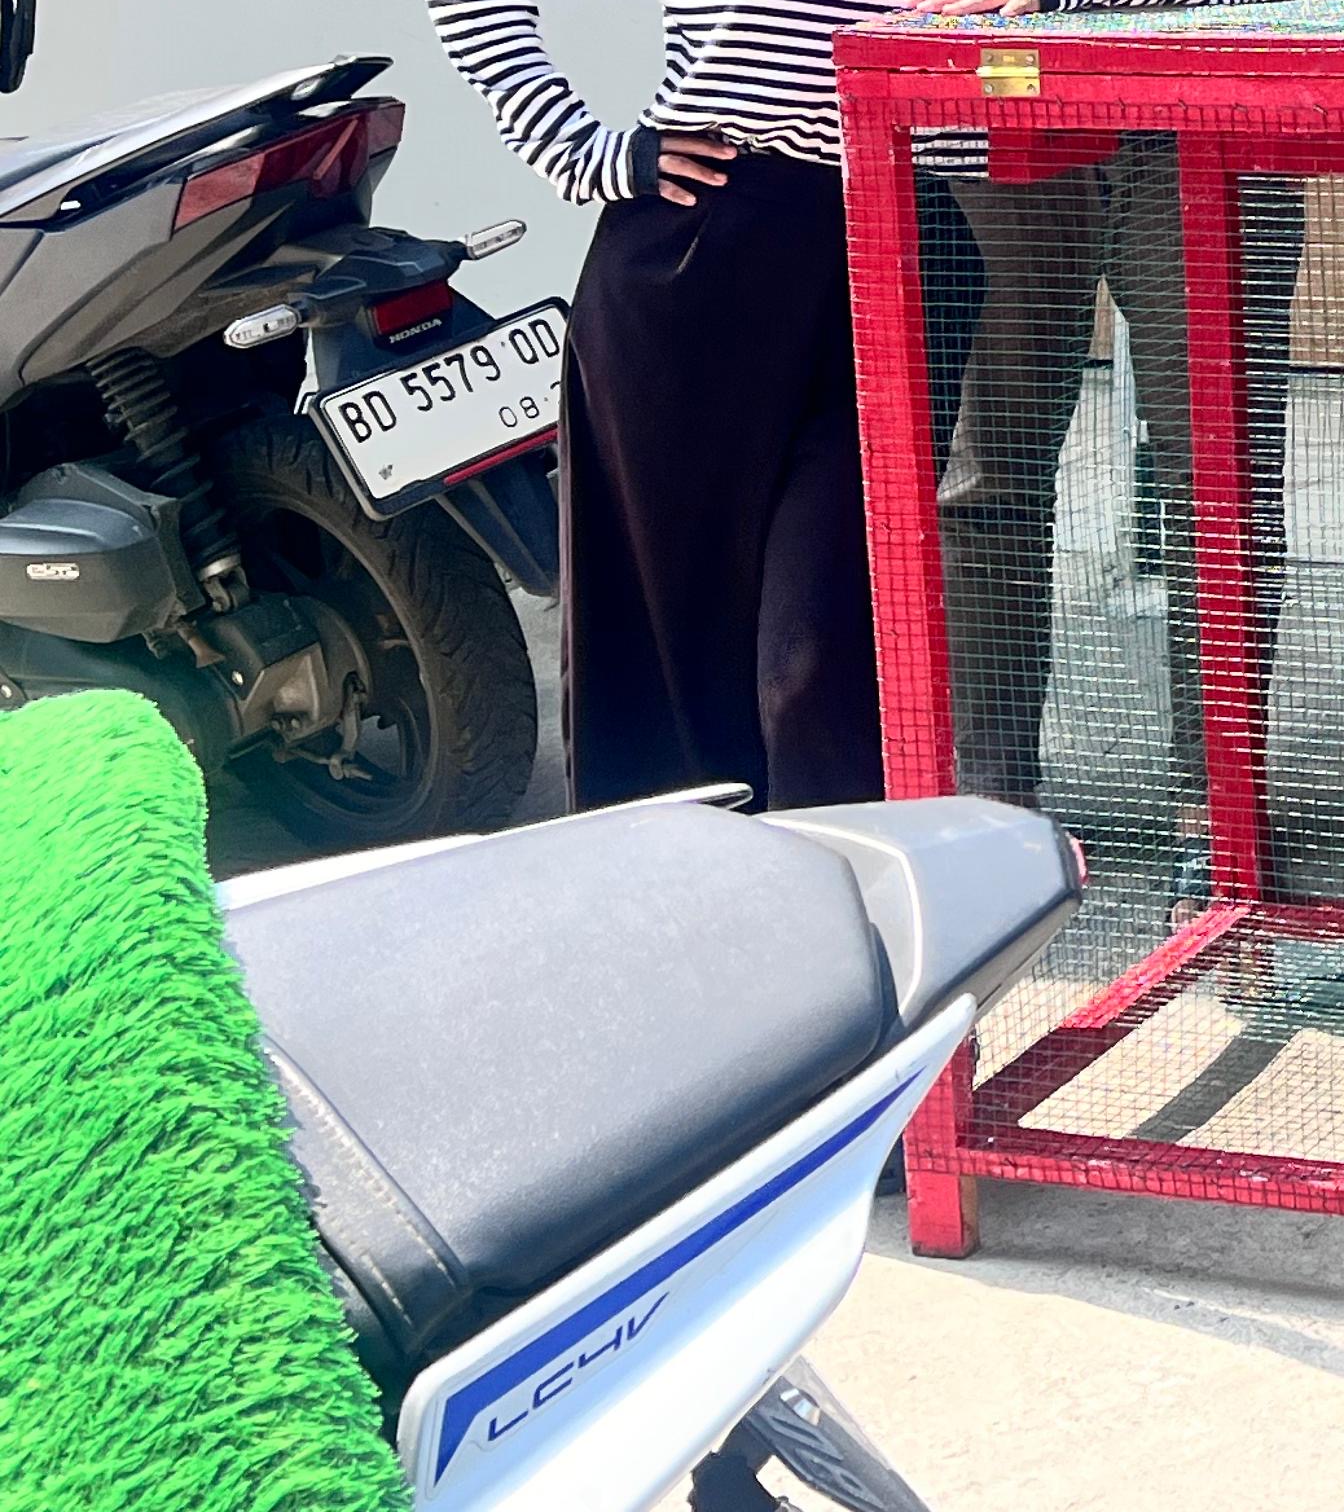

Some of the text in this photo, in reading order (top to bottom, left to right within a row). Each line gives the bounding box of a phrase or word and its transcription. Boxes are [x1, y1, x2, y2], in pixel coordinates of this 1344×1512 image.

[388, 318, 443, 344] HONDA
[338, 390, 397, 444] BD
[400, 345, 501, 412] 5579
